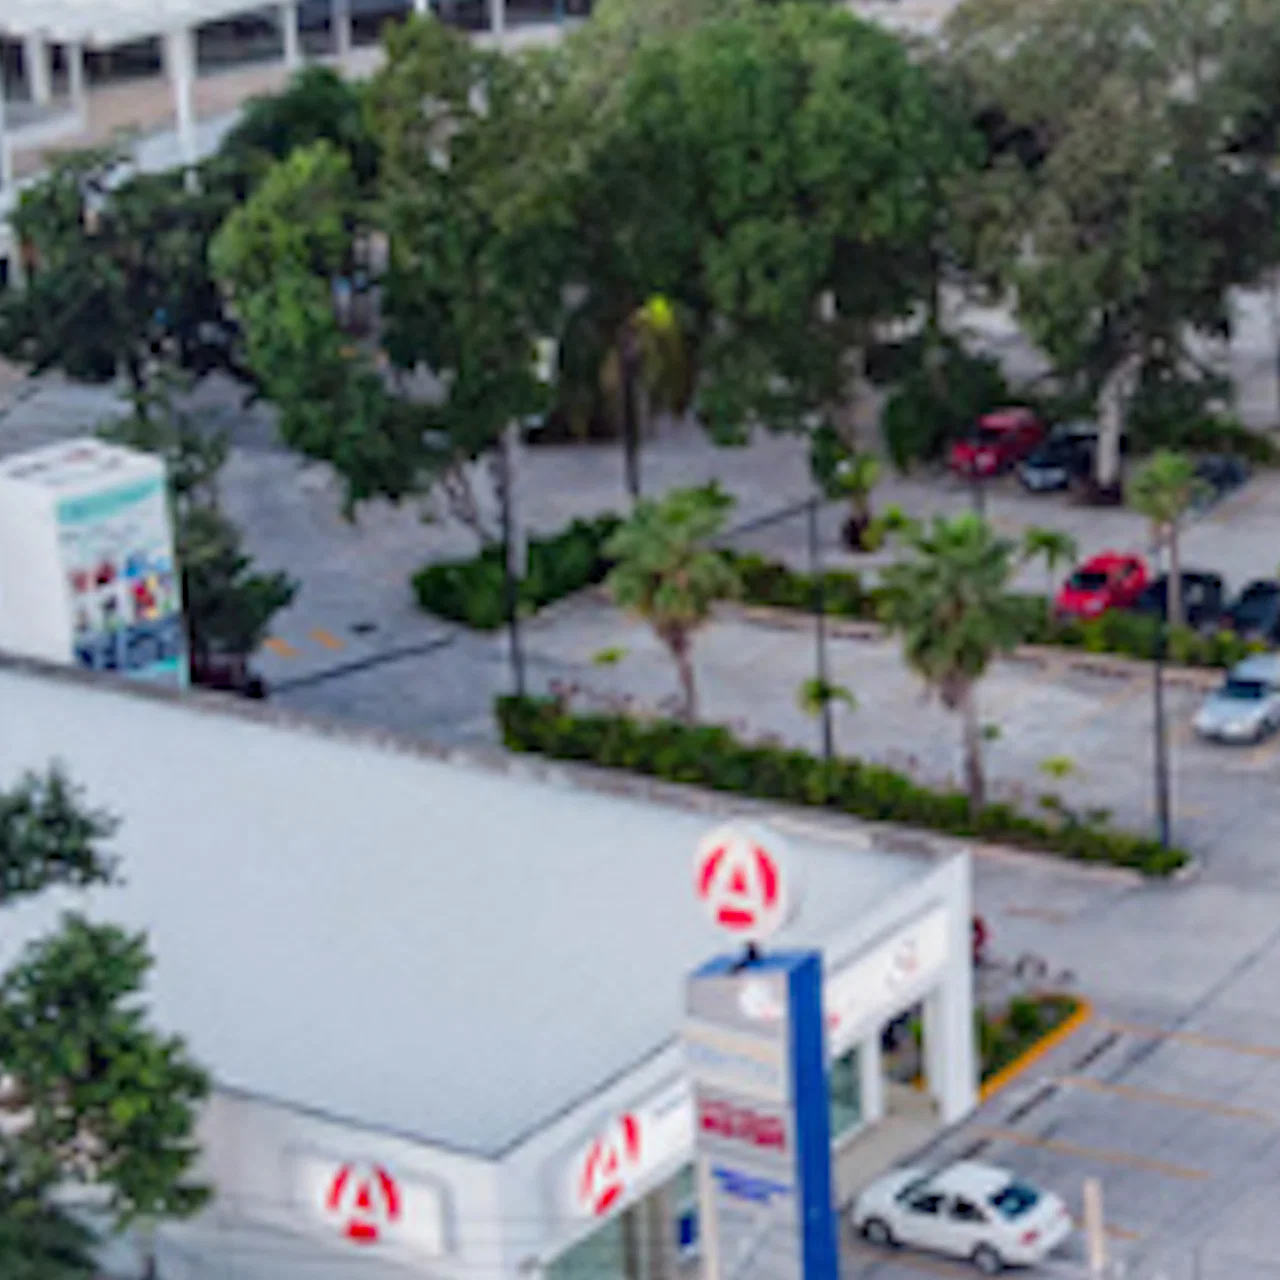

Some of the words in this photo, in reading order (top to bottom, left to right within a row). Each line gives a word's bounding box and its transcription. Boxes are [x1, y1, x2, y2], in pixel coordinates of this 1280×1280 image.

[696, 838, 780, 930] A
[325, 1163, 402, 1244] A
[581, 1113, 641, 1216] A
